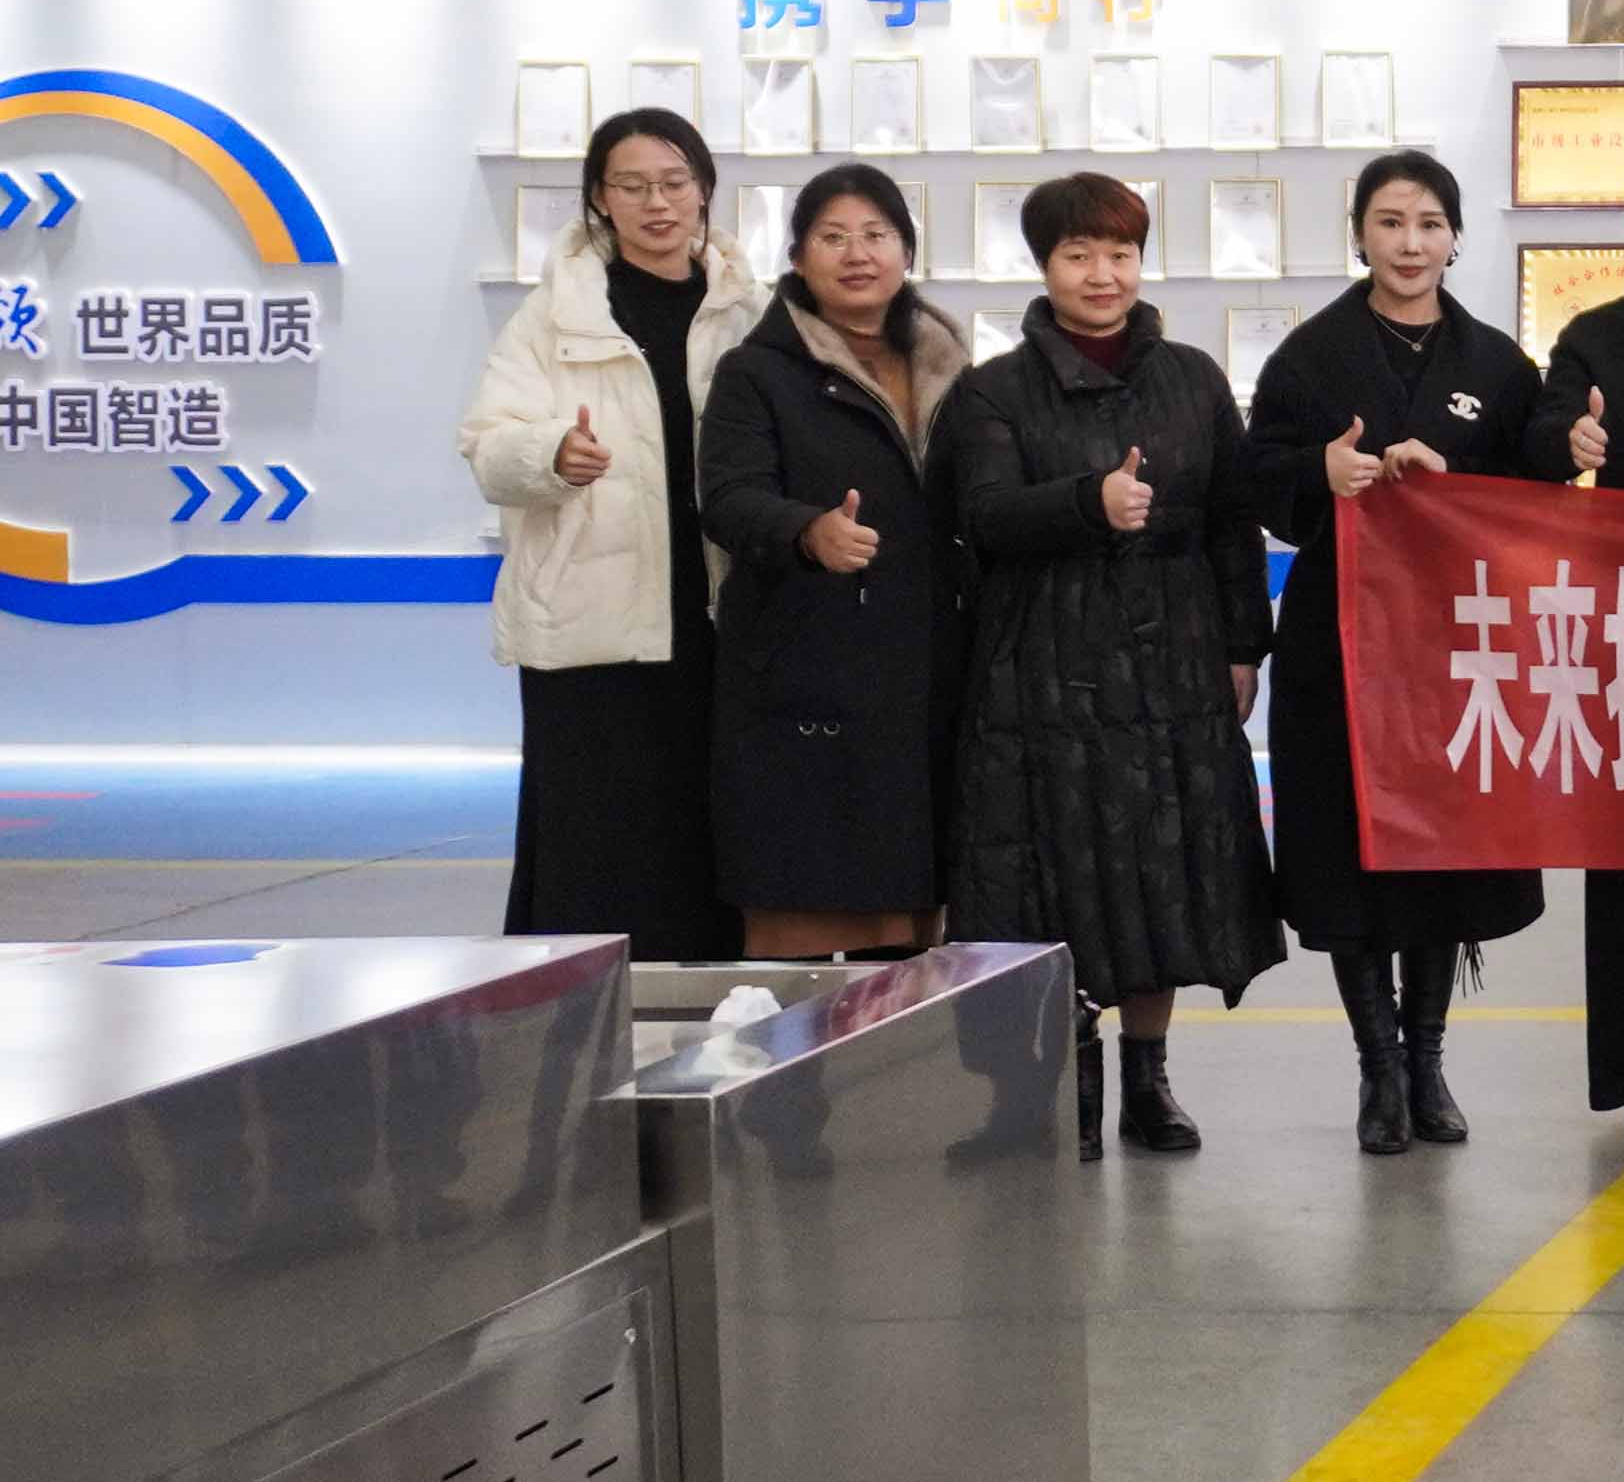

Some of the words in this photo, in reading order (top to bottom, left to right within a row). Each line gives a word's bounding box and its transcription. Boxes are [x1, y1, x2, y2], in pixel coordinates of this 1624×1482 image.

[77, 296, 313, 356] 世界品质
[0, 385, 222, 447] 中国智造
